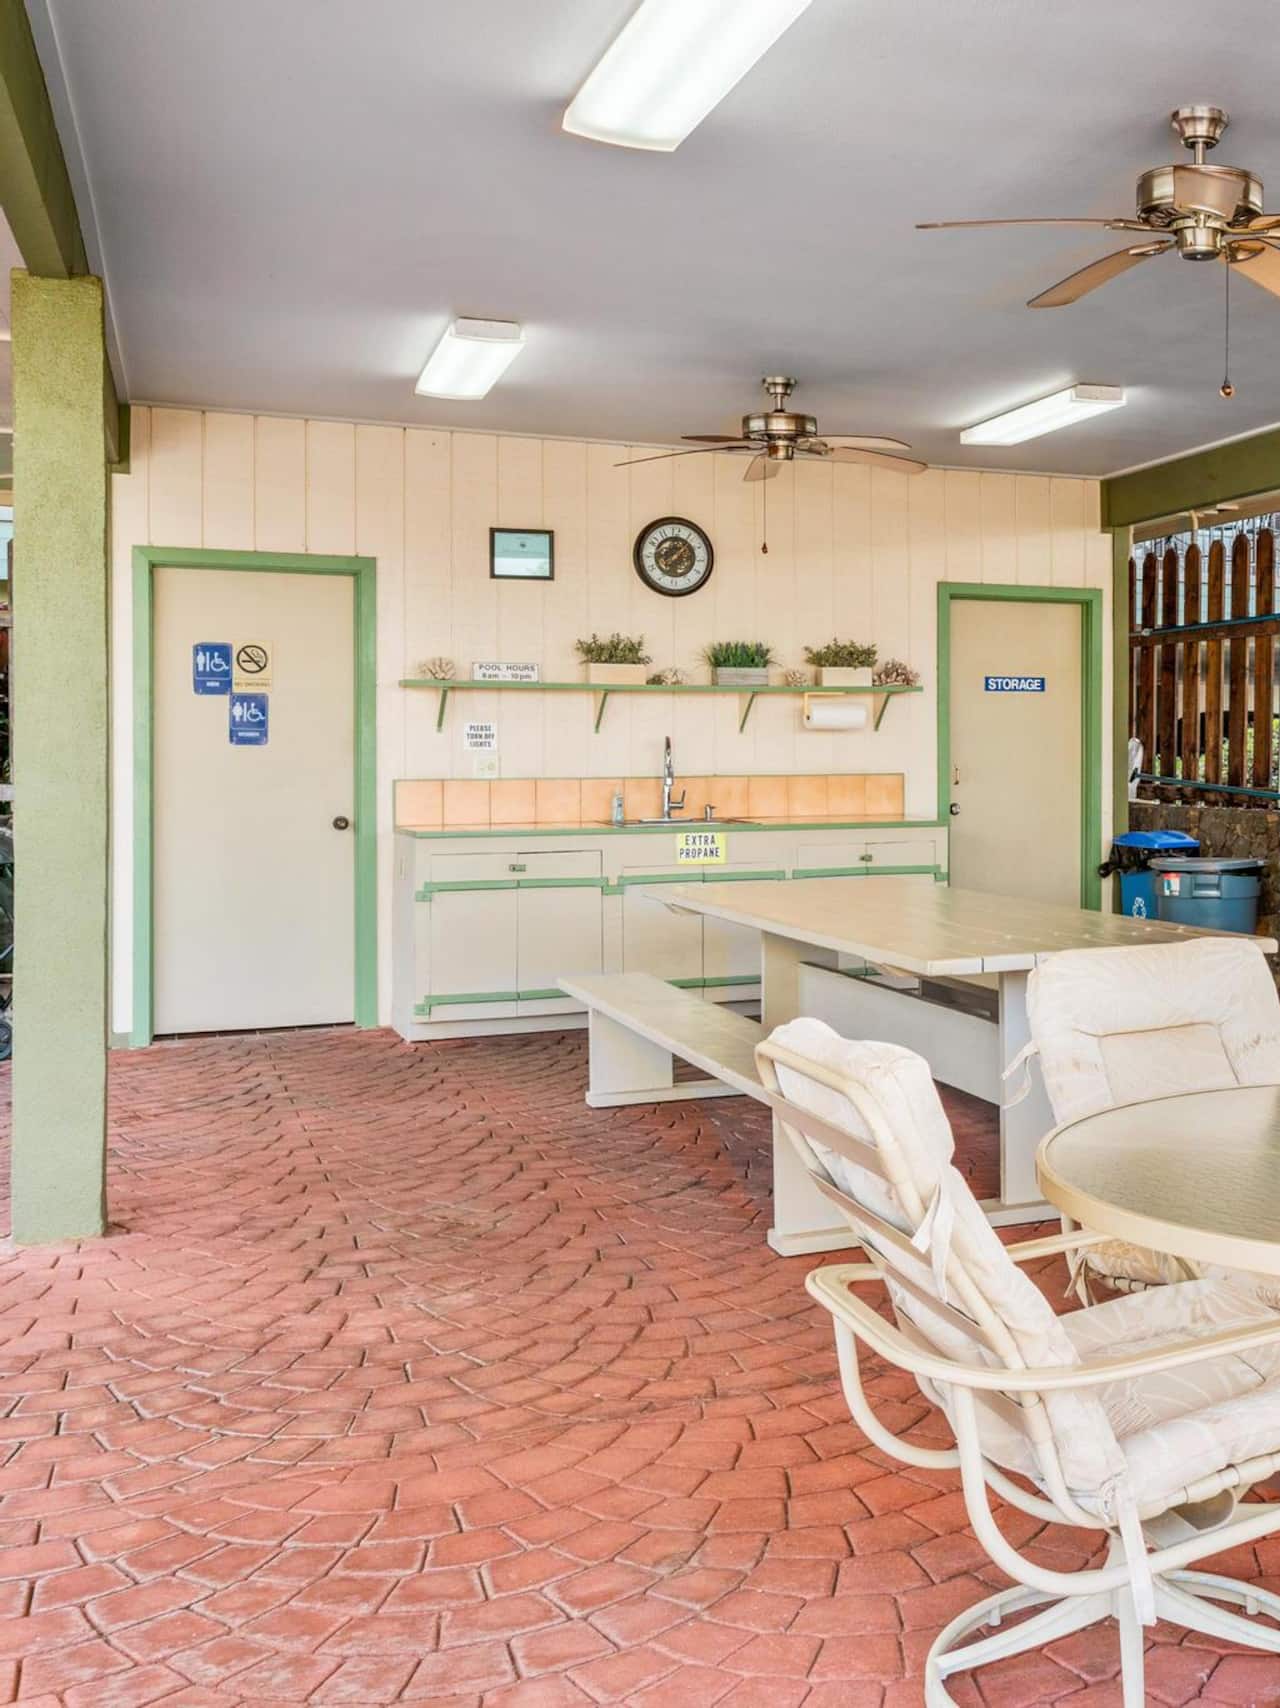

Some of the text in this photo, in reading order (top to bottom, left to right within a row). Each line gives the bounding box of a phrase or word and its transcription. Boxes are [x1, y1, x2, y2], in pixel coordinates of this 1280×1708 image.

[988, 678, 1042, 690] STORAGE
[469, 724, 492, 732] PLEASE
[469, 740, 492, 748] LIGHTS
[685, 834, 716, 846] EXTRA
[680, 847, 720, 859] PROPANE
